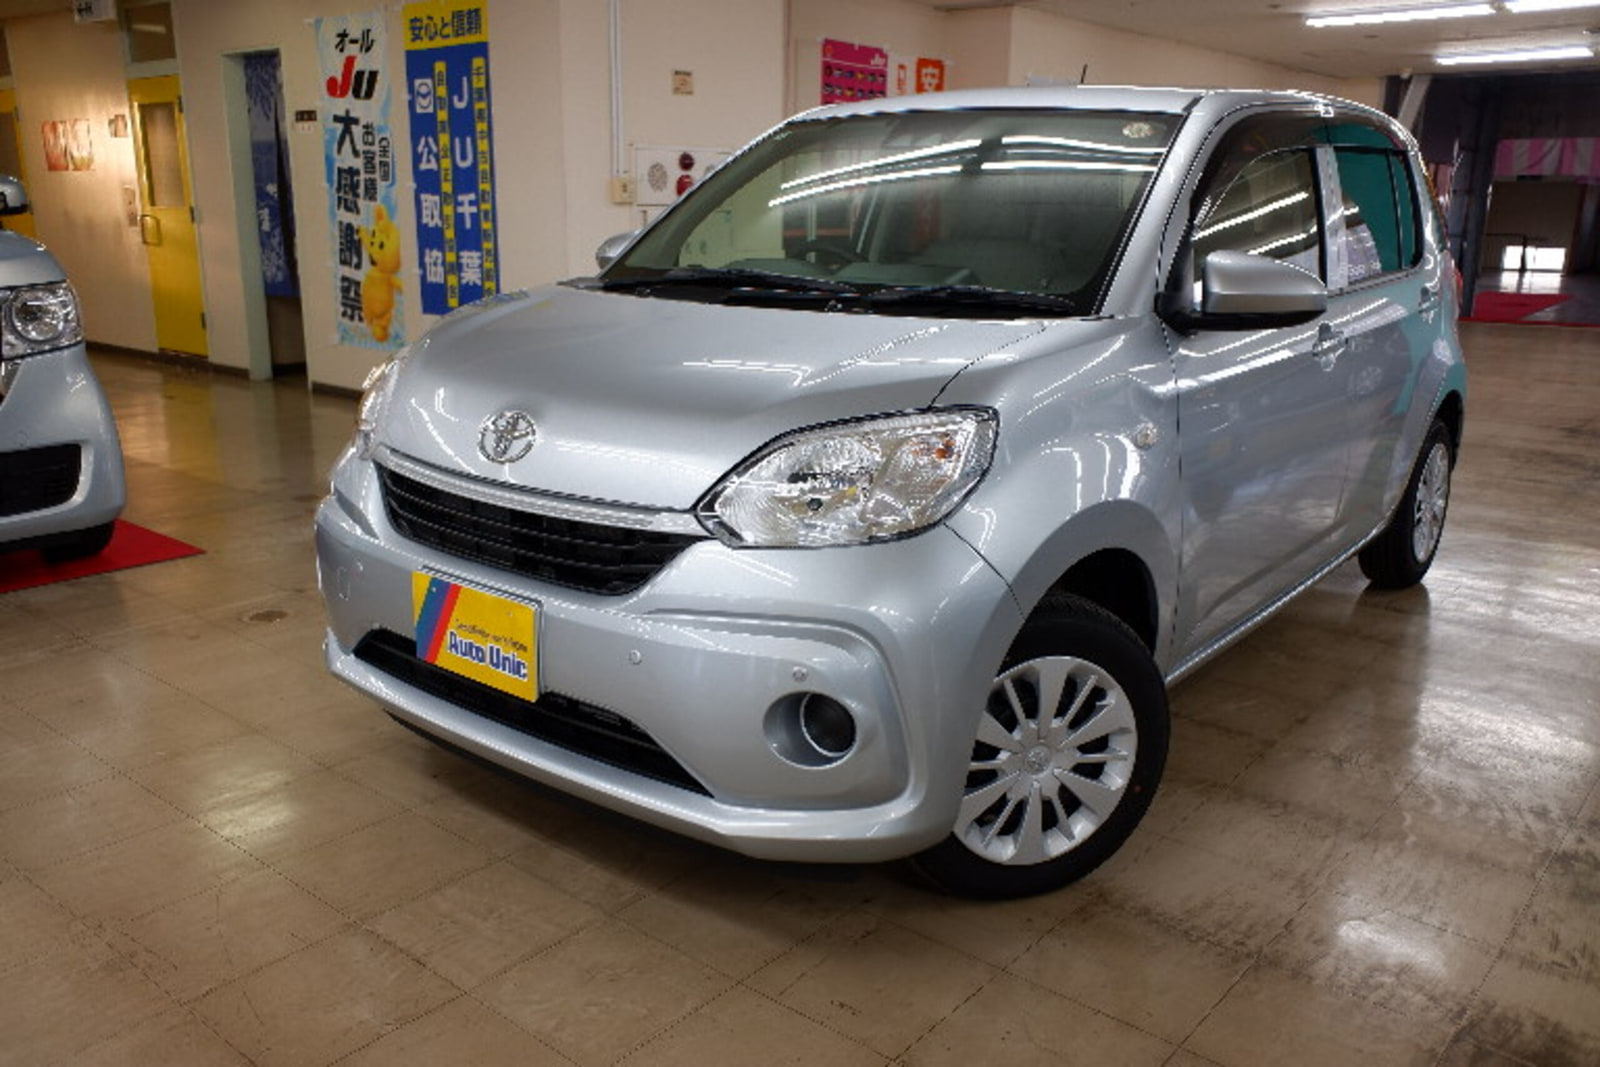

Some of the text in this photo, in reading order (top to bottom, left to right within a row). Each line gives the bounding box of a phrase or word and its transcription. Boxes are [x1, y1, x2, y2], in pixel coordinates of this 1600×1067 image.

[335, 28, 375, 53] オール
[409, 8, 482, 42] 安心と信頼
[326, 55, 379, 100] JU
[448, 630, 486, 664] Auto
[488, 645, 528, 680] Unic
